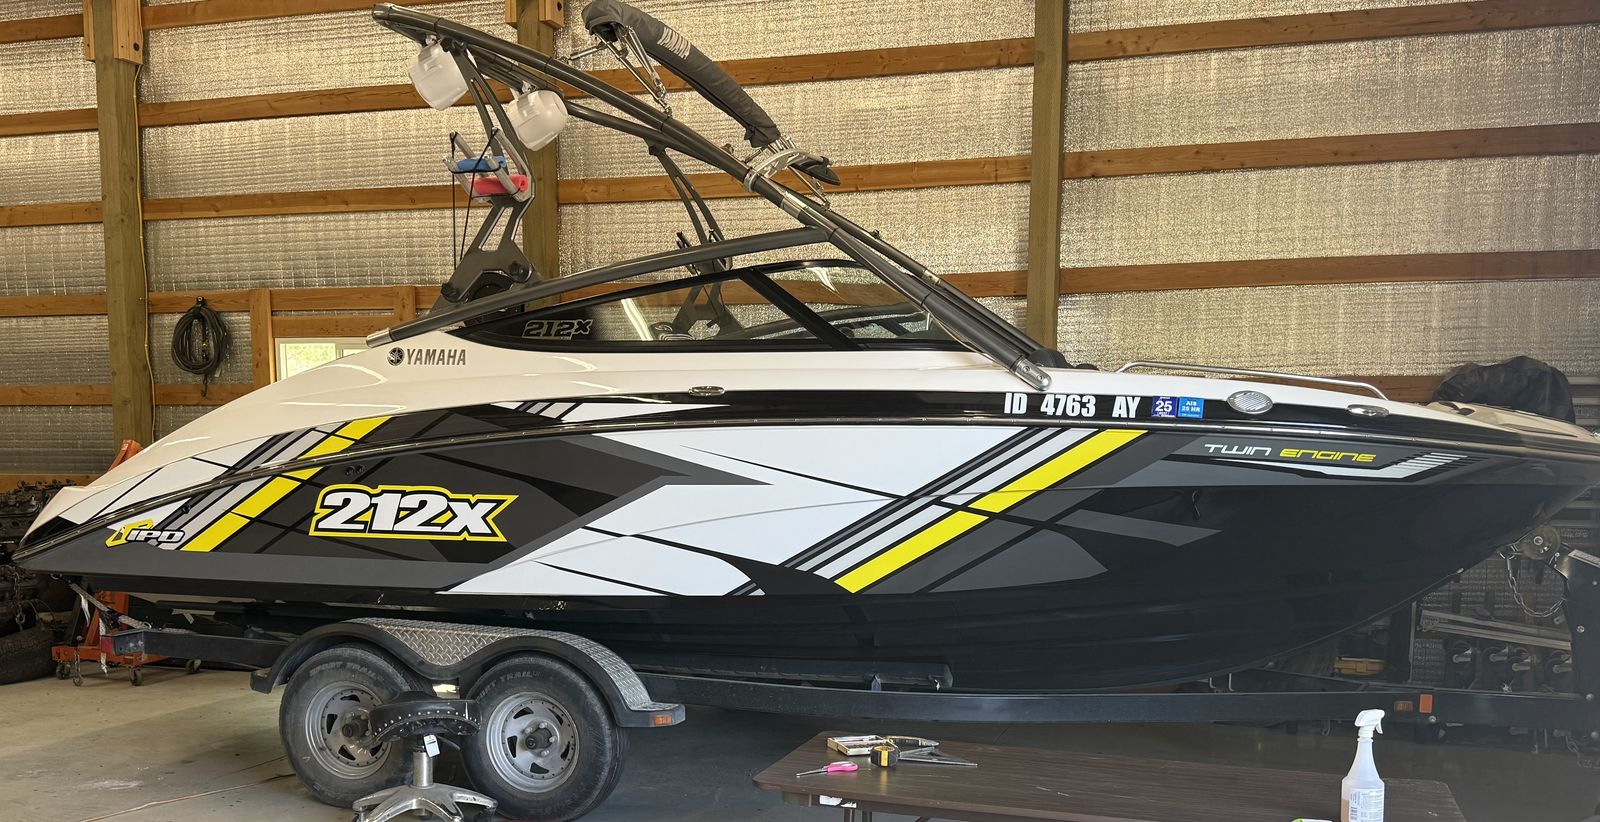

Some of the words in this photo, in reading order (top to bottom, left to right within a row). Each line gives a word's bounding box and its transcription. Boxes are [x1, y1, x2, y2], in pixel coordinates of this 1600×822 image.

[406, 348, 467, 366] YAMAHA
[1003, 392, 1028, 415] ID
[1040, 393, 1096, 417] 4763
[1111, 396, 1141, 418] AY
[1154, 400, 1173, 412] 25
[1204, 444, 1272, 456] TWIN
[1279, 448, 1377, 462] ENGINE
